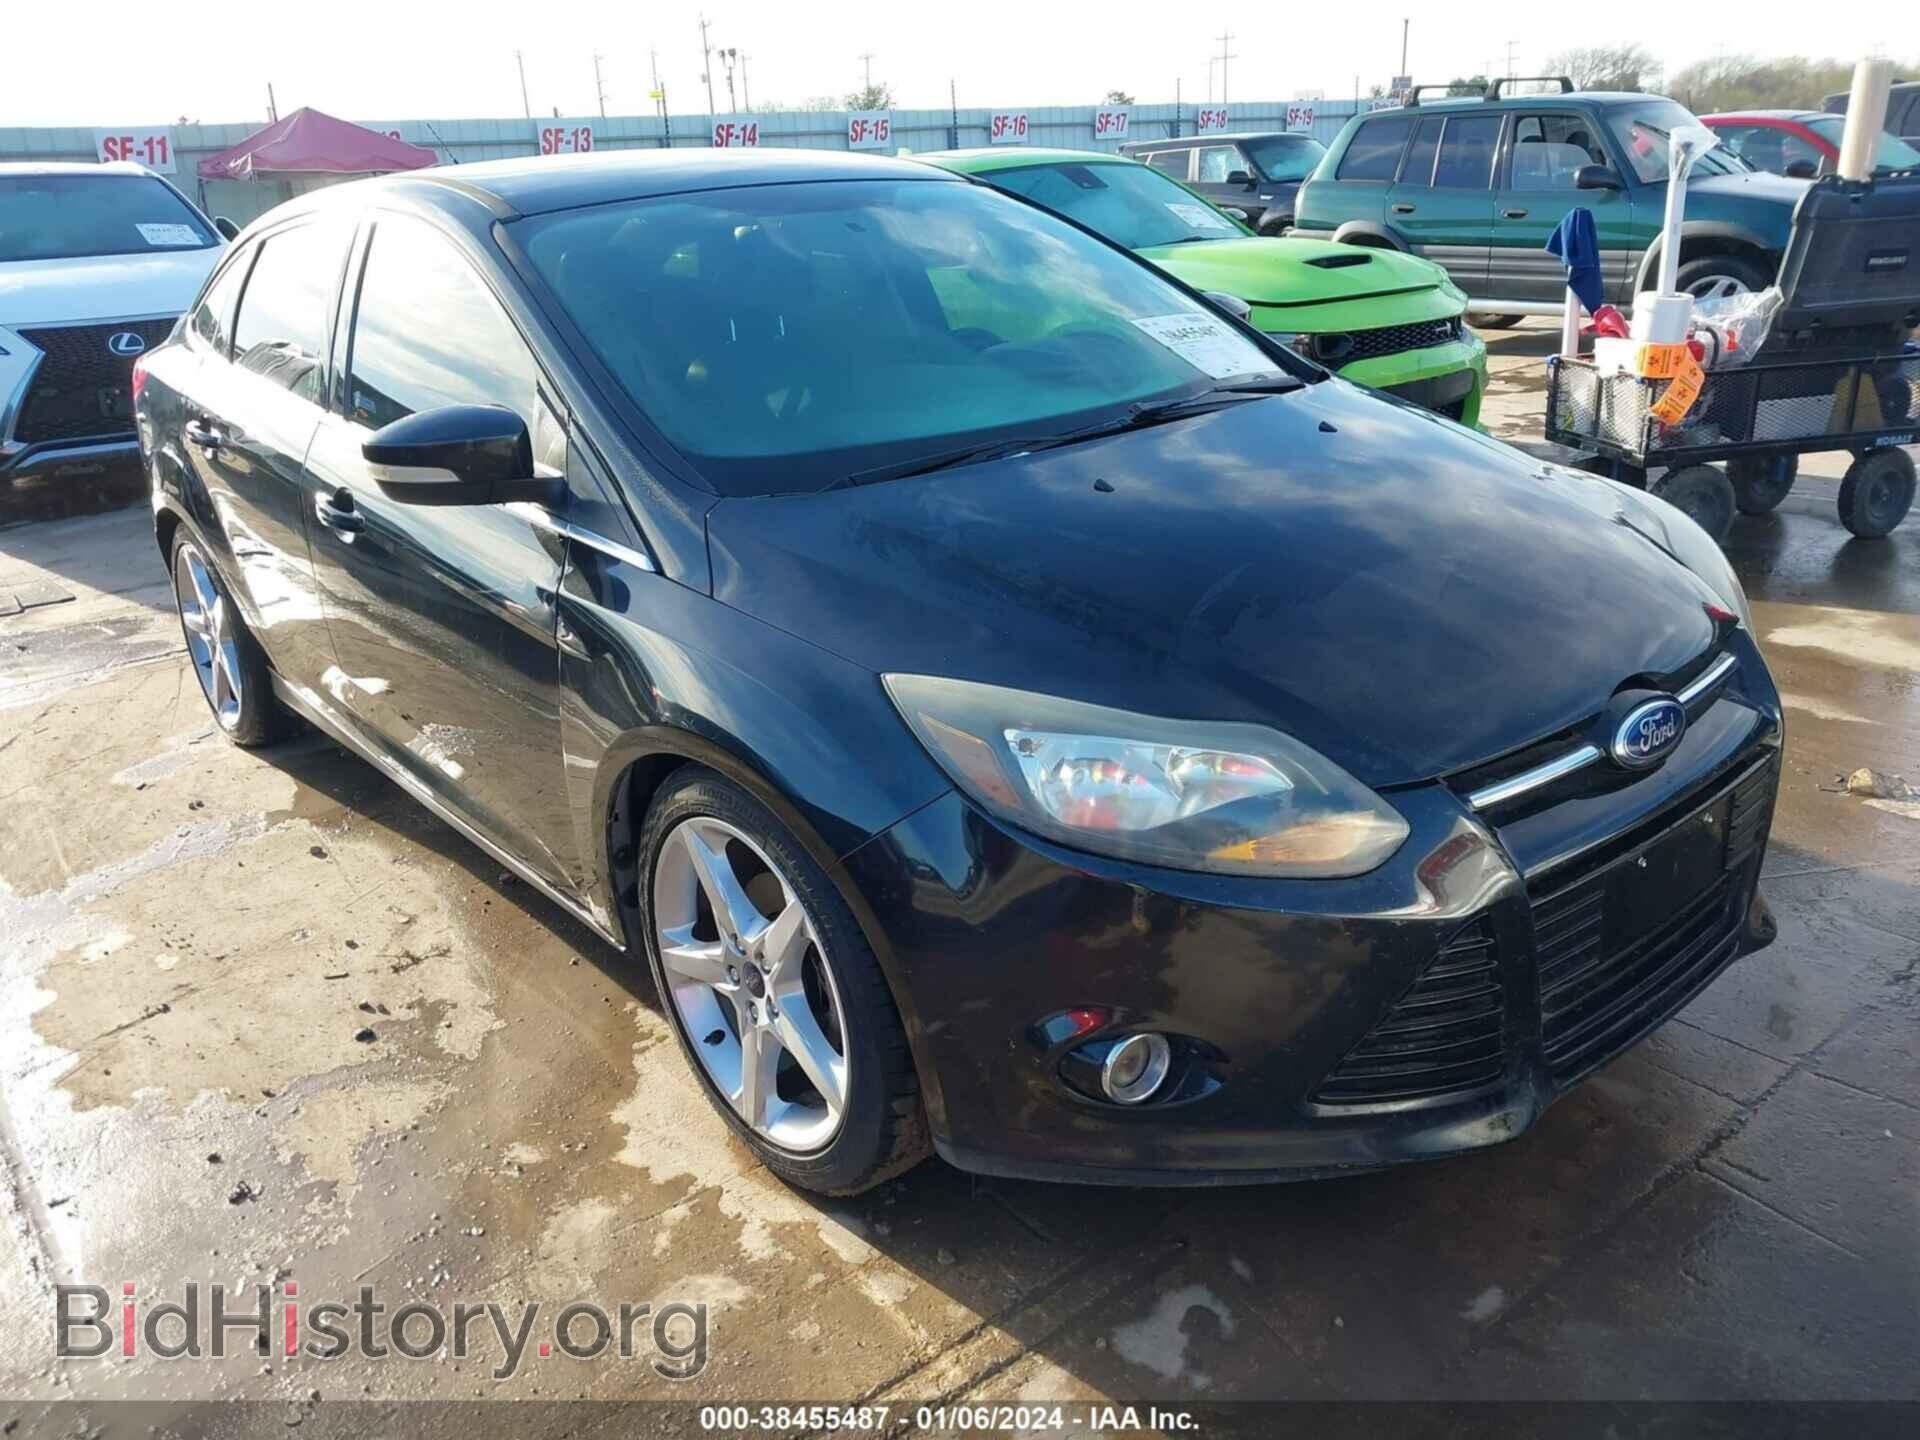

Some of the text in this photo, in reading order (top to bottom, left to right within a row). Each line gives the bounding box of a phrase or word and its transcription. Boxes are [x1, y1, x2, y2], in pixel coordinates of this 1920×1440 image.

[992, 114, 1027, 137] SF-16
[1096, 112, 1127, 133] SF-17
[1199, 109, 1228, 129] SF-18
[1286, 108, 1314, 127] SF-19
[541, 126, 591, 156] SF-13
[714, 122, 758, 148] SF-14
[850, 118, 889, 142] SF-15
[102, 135, 169, 164] SF-11
[1639, 710, 1676, 752] Ford
